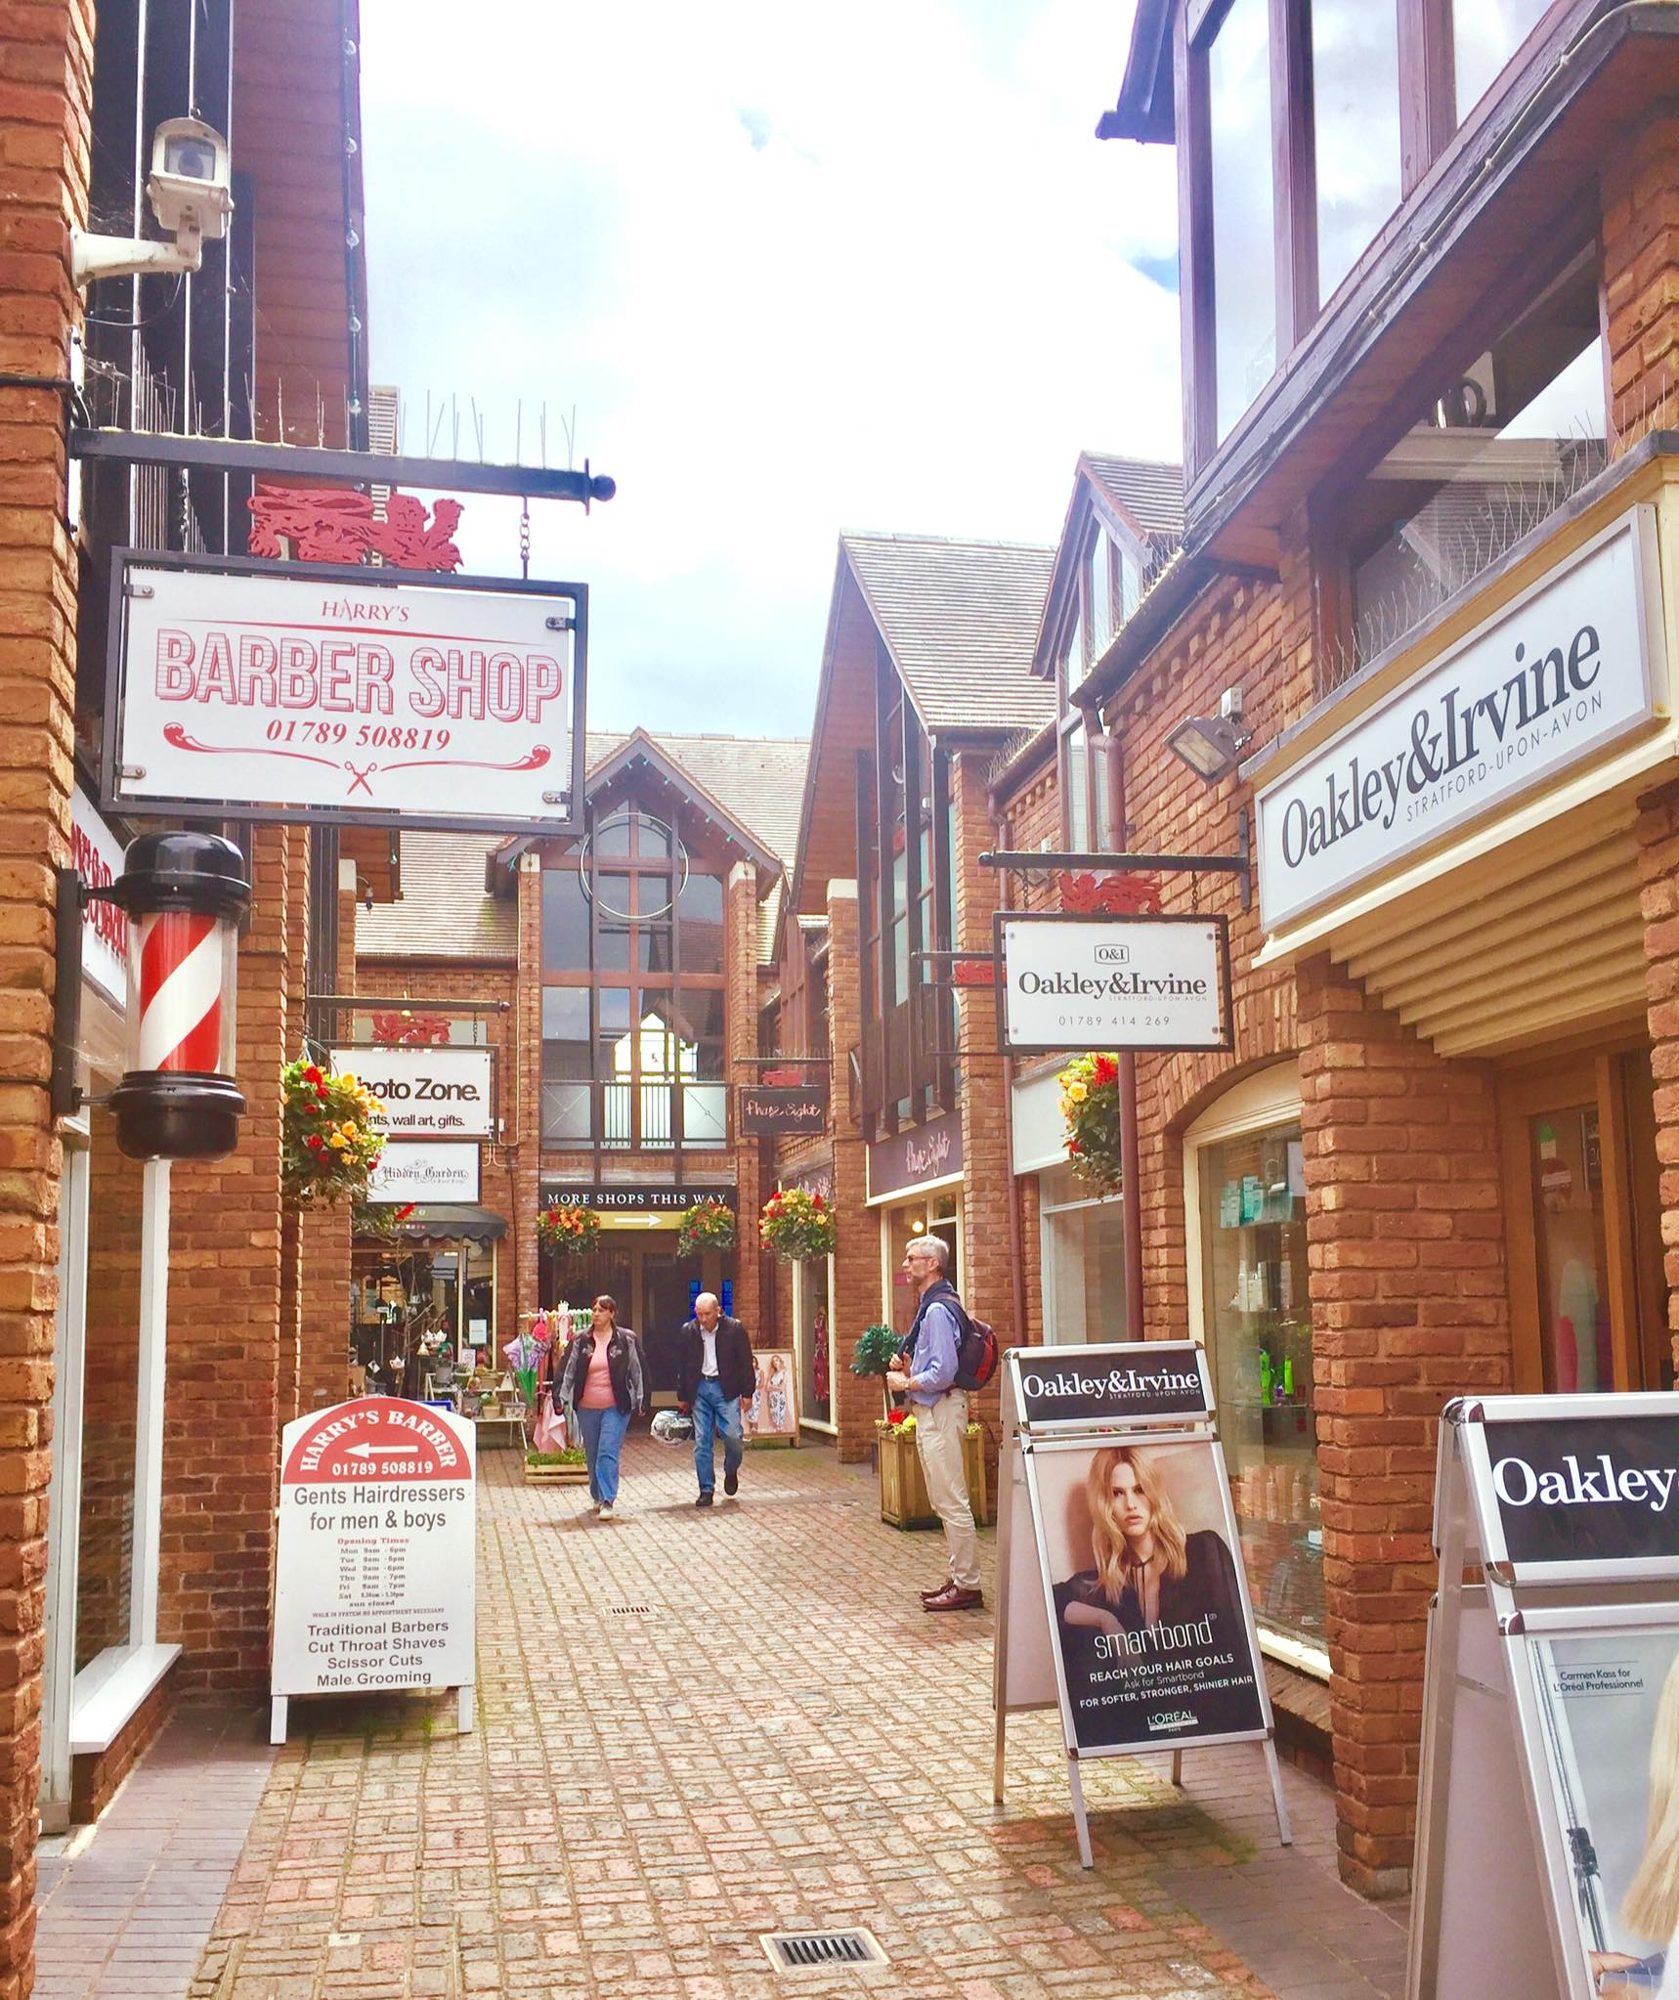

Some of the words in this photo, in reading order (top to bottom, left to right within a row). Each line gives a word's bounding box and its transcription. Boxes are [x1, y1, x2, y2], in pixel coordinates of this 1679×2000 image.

[320, 598, 409, 623] HARRY'S
[155, 628, 395, 715] BARBER
[409, 646, 562, 723] SHOP
[266, 719, 347, 746] 01789
[356, 725, 452, 751] 508819
[1282, 624, 1600, 869] Oakley&Irvine
[1405, 690, 1602, 823] STRATFORD-UPON-AVON
[1098, 948, 1125, 960] O&I
[1019, 971, 1207, 1000] Oakley&Irvine
[1058, 1016, 1103, 1026] 01789
[1112, 1016, 1136, 1026] 414
[1145, 1016, 1170, 1026] 269
[357, 1077, 411, 1100] hoto
[415, 1078, 481, 1101] Zone.
[392, 1115, 416, 1126] wall
[418, 1115, 436, 1127] art,
[438, 1114, 465, 1128] gifts.
[383, 1166, 420, 1178] Hidden
[548, 1193, 591, 1205] MORE
[596, 1193, 645, 1205] SHOPS
[651, 1193, 687, 1205] THIS
[693, 1193, 726, 1205] WAY
[1023, 1368, 1200, 1400] Oakley&Irvine
[301, 1410, 380, 1471] HARRY'S
[387, 1410, 458, 1467] BARBER
[332, 1462, 377, 1476] 01789
[381, 1461, 434, 1475] 508819
[294, 1487, 347, 1505] Gents
[353, 1485, 466, 1504] Hairdressers
[310, 1512, 336, 1530] for
[341, 1515, 379, 1529] men
[385, 1510, 398, 1528] &
[404, 1510, 446, 1532] boys
[307, 1622, 387, 1637] Traditional
[391, 1620, 449, 1634] Barbers
[308, 1641, 334, 1653] Cut
[339, 1639, 388, 1652] Throat
[392, 1637, 446, 1650] Shaves
[327, 1656, 384, 1670] Scissor
[389, 1654, 423, 1666] Cuts
[1089, 1668, 1128, 1683] REACH
[1131, 1663, 1163, 1677] YOUR
[1166, 1658, 1194, 1672] HAIR
[1196, 1653, 1234, 1668] GOALS
[317, 1674, 352, 1686] Male
[357, 1671, 432, 1686] Grooming
[1124, 1680, 1140, 1690] Ask
[1142, 1677, 1154, 1687] for
[1157, 1670, 1205, 1685] Smartbond
[1560, 1671, 1596, 1681] Carmen
[1596, 1669, 1617, 1678] Kass
[1617, 1668, 1631, 1677] for
[1586, 1678, 1643, 1691] Professionnel
[1080, 1697, 1099, 1708] FOR
[1101, 1692, 1139, 1706] SOFTER,
[1141, 1685, 1192, 1700] STRONGER,
[1194, 1679, 1230, 1692] SHINIER
[1232, 1675, 1254, 1687] HAIR
